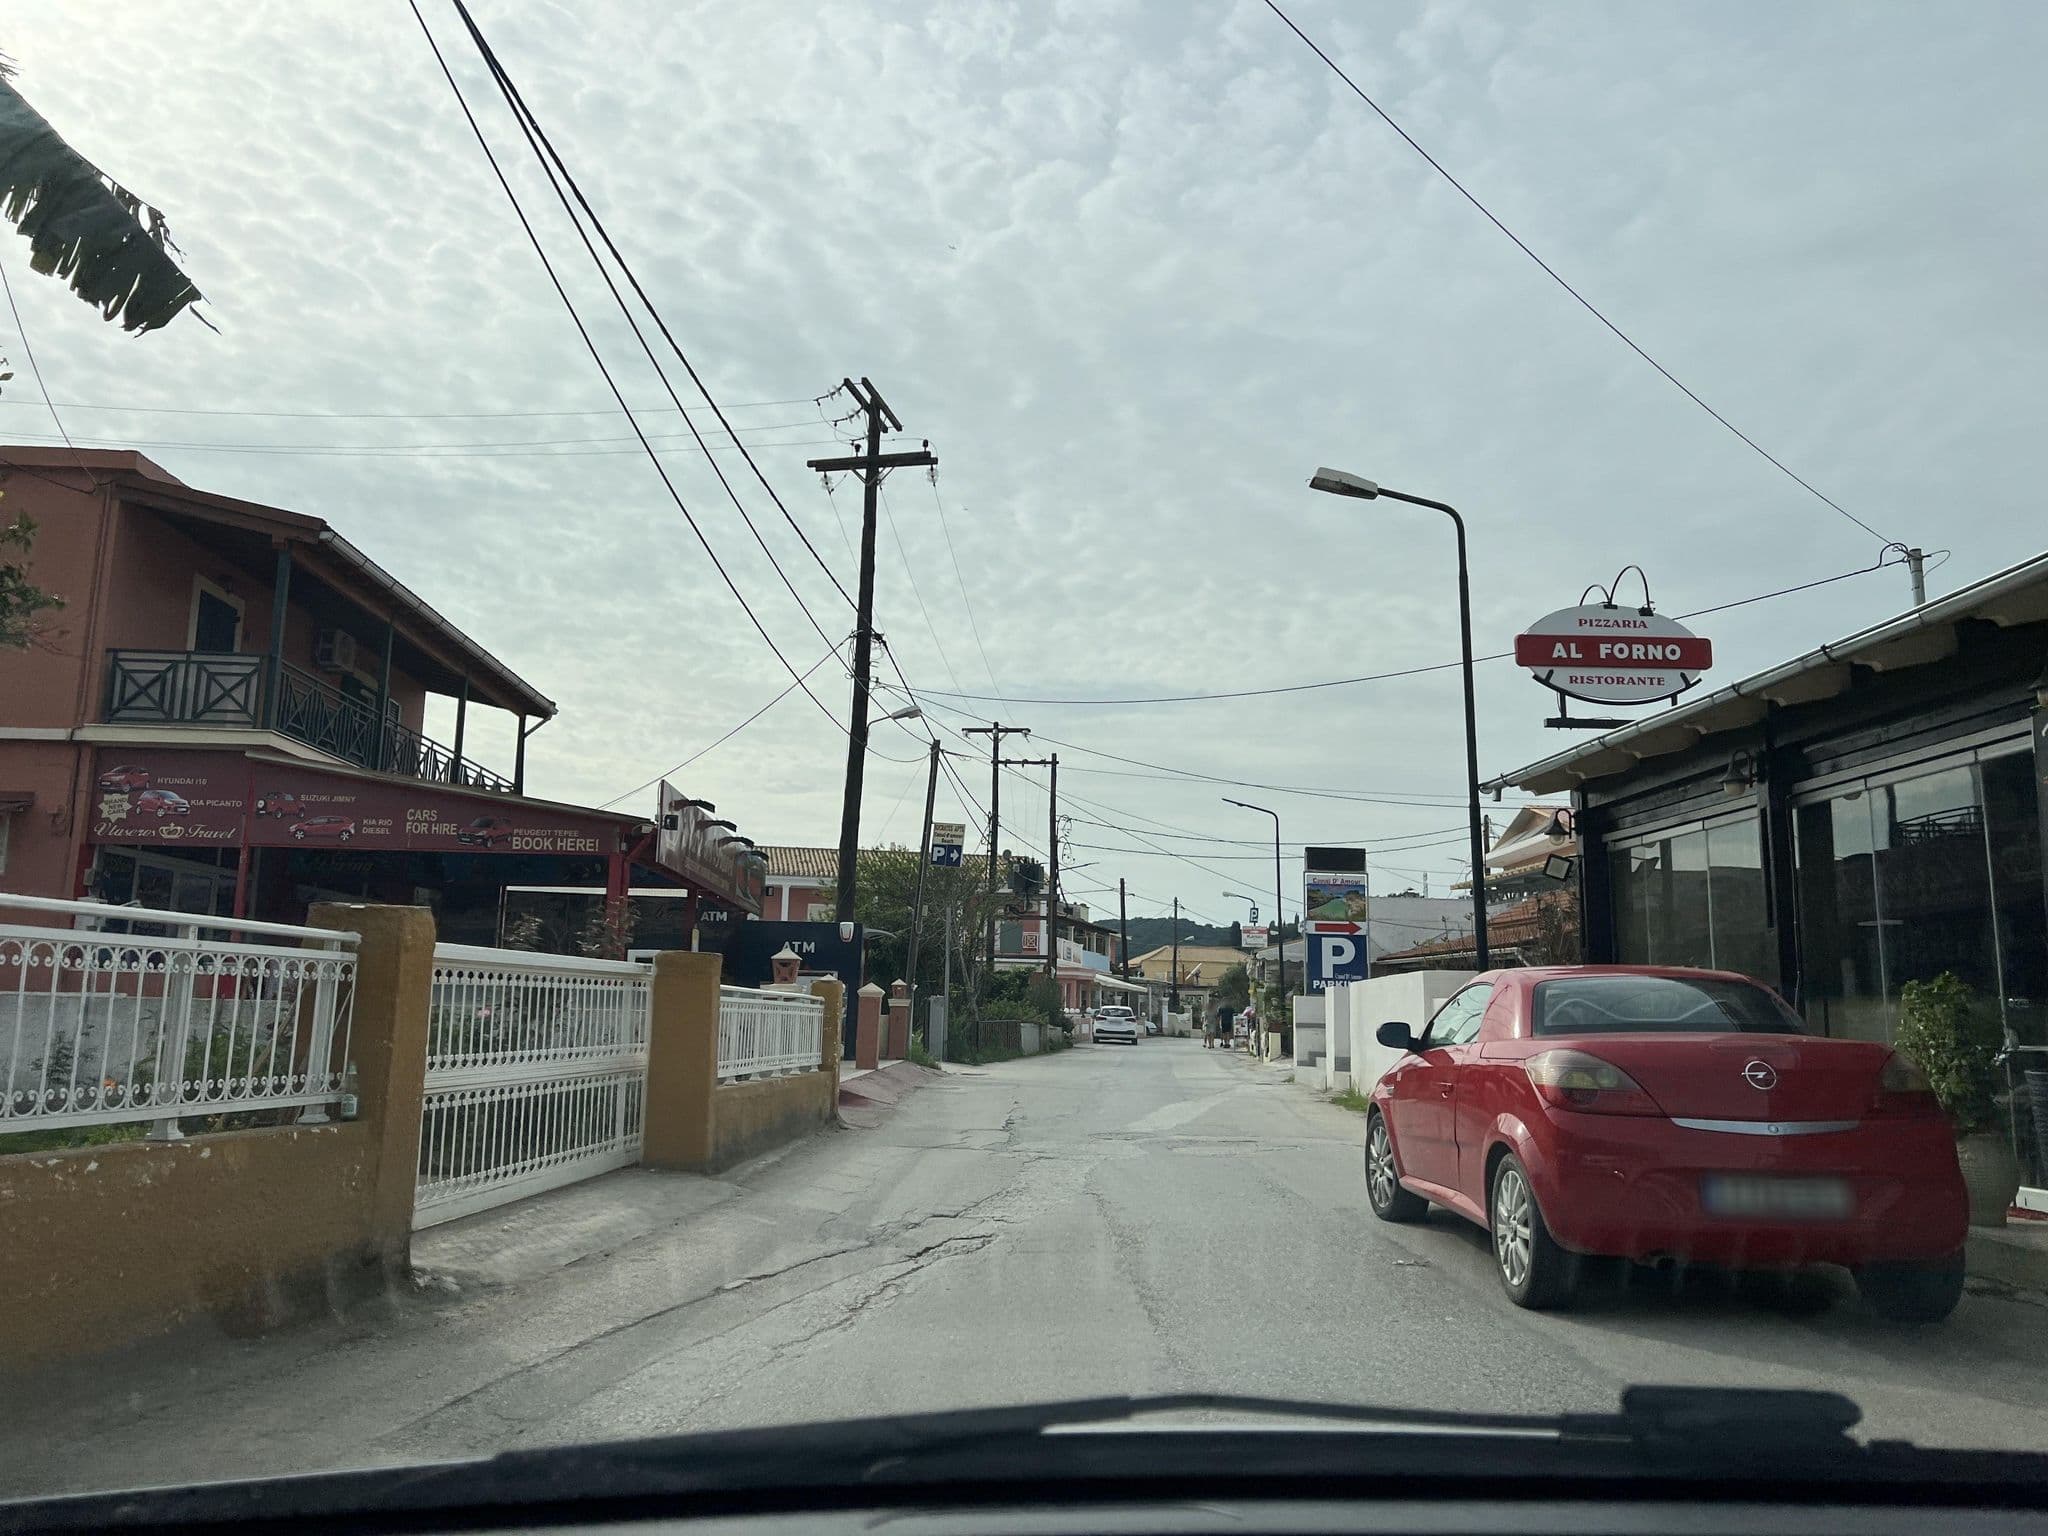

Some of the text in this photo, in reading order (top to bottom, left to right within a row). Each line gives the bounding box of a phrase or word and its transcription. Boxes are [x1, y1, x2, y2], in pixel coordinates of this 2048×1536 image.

[1578, 618, 1648, 629] PIZZARIA
[1552, 642, 1681, 661] AL FORNO
[1568, 675, 1665, 686] RISTORANTE
[157, 777, 195, 785] HYUNDAI
[300, 794, 330, 802] SUZUKI
[206, 800, 243, 808] PICANTO
[407, 808, 438, 822] CARS
[363, 818, 377, 826] KIA
[185, 824, 237, 839] Travel
[362, 827, 391, 835] DIESEL
[406, 822, 458, 836] FOR HIRE
[513, 828, 552, 837] PEUGEOT
[512, 836, 599, 852] BOOK HERE!
[932, 847, 945, 861] P
[700, 911, 728, 922] ATM
[1251, 909, 1258, 921] P
[782, 941, 815, 954] ATM
[1321, 937, 1355, 979] P
